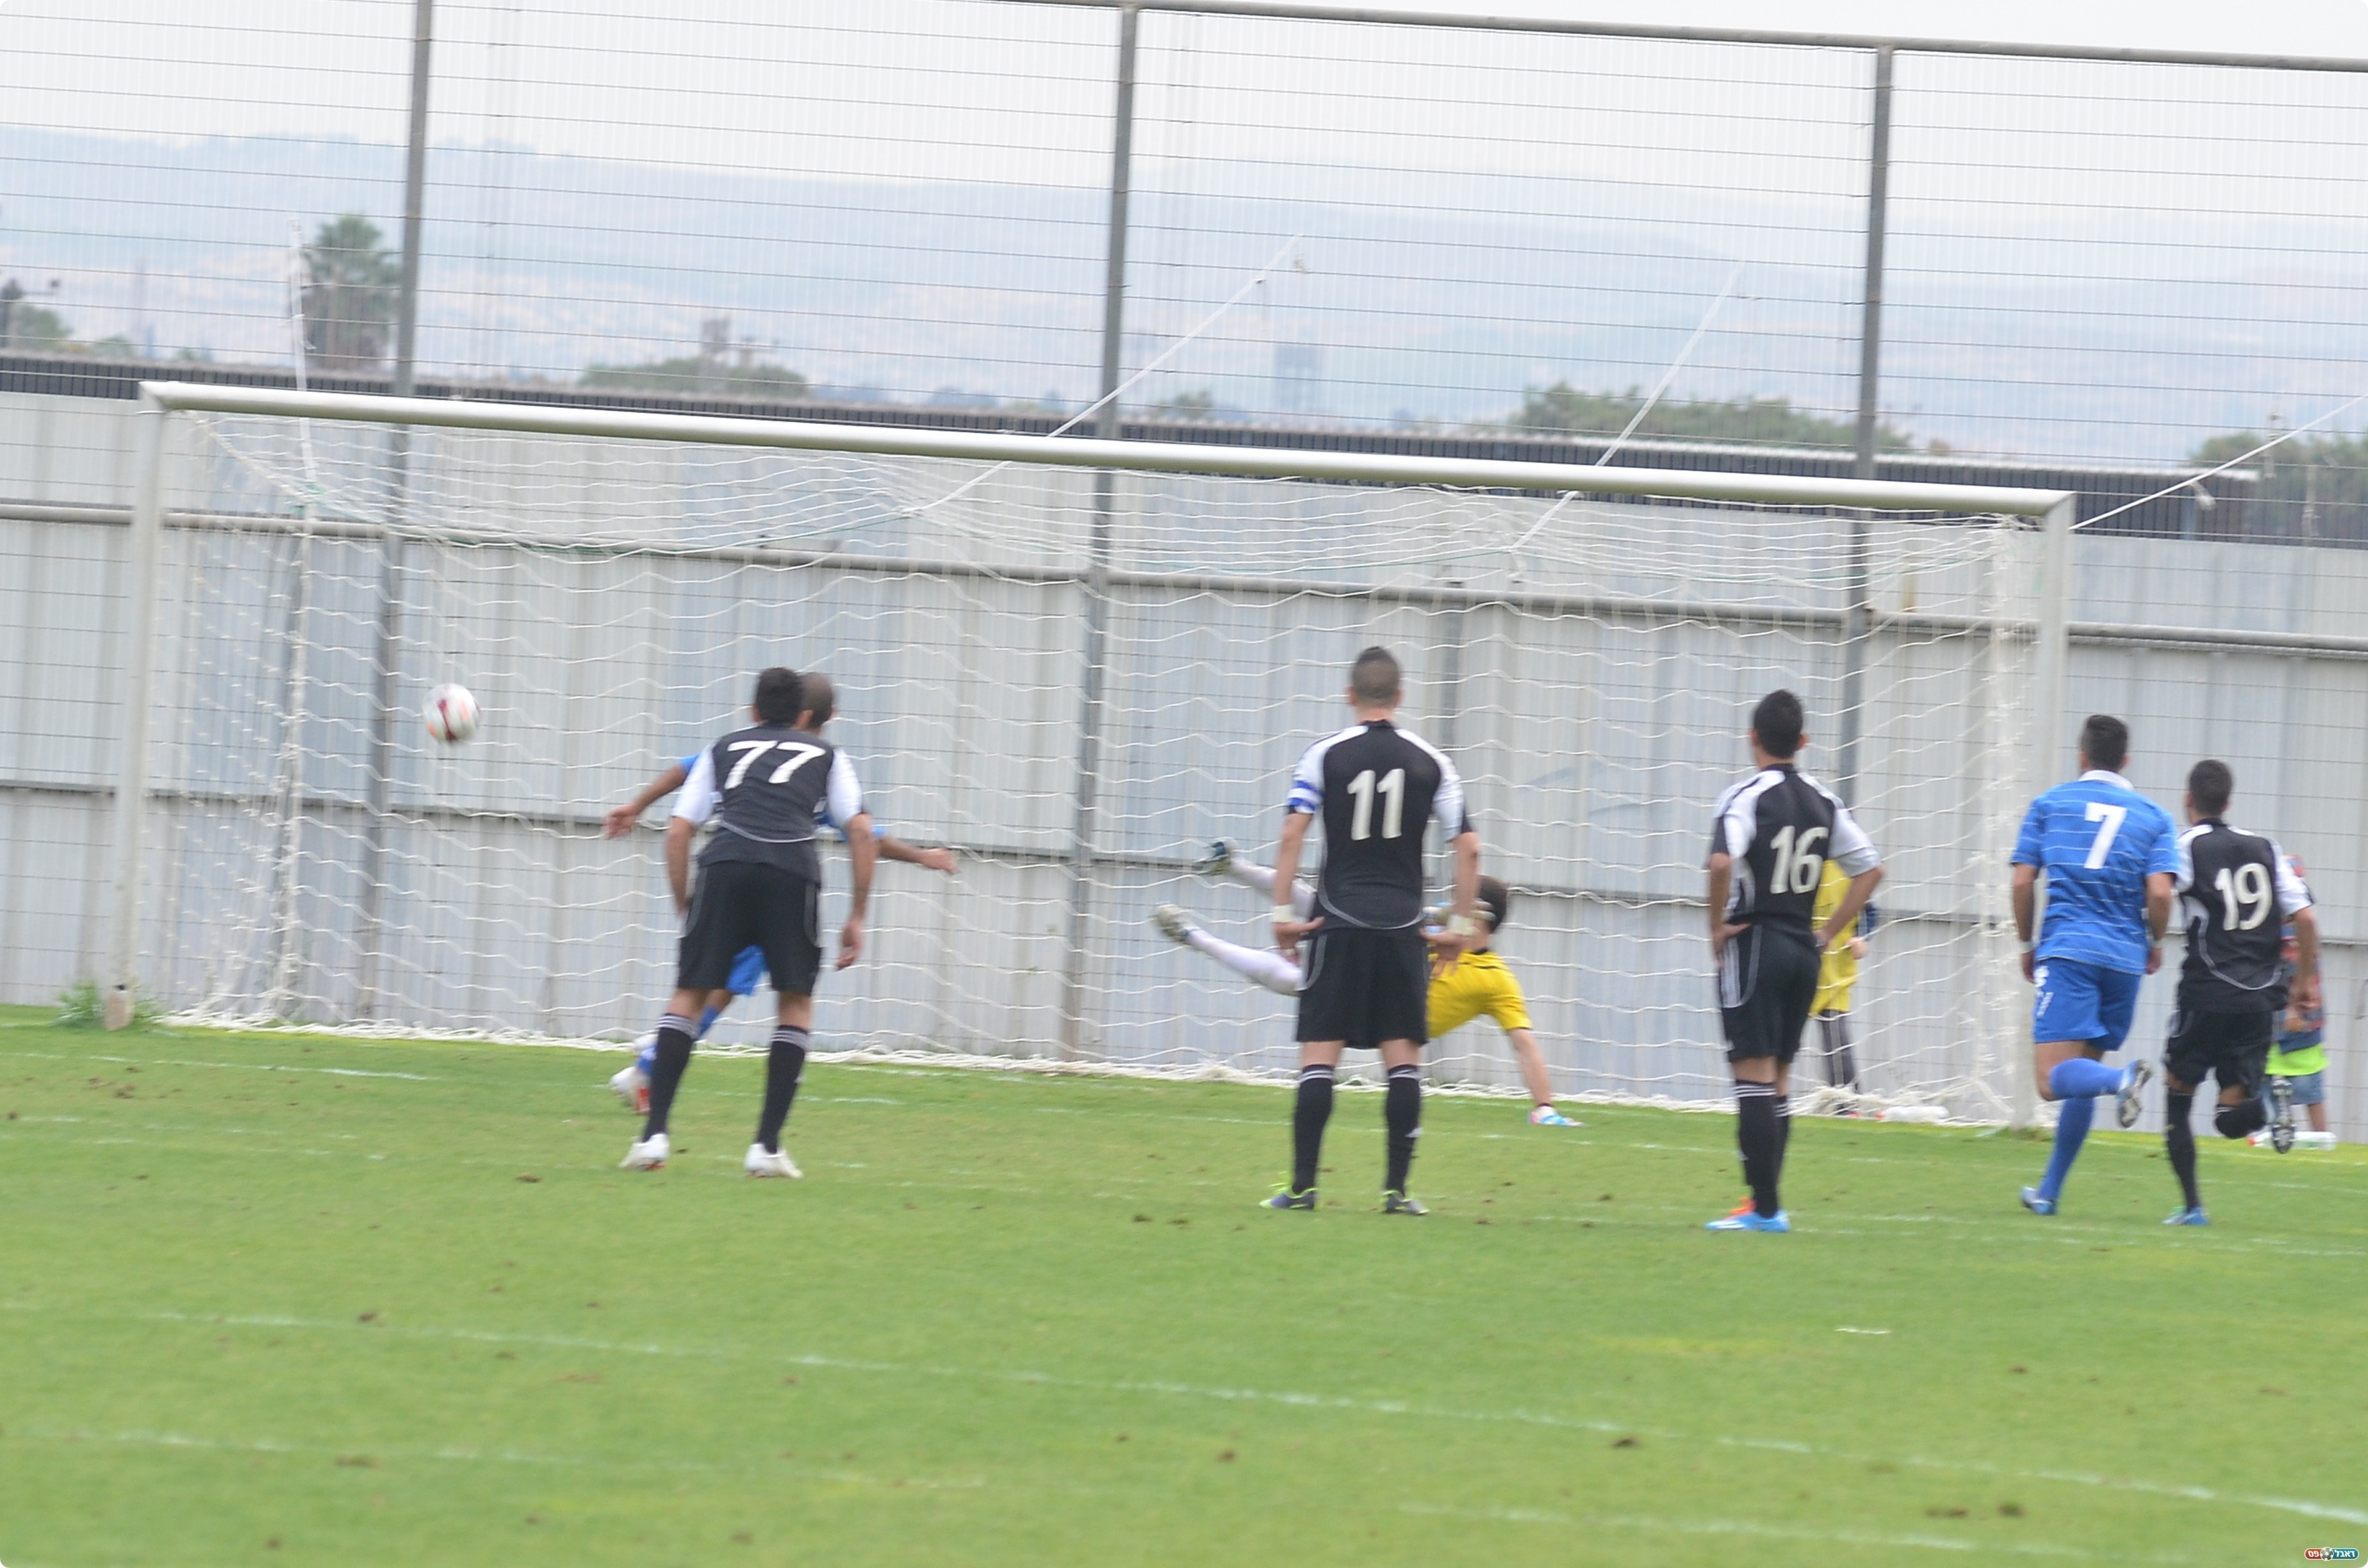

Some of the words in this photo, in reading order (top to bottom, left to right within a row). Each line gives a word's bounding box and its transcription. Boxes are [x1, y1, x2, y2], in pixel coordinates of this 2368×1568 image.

[724, 740, 826, 790] 77
[1347, 768, 1406, 841] 11
[2084, 801, 2128, 870] 7
[1769, 825, 1829, 895] 16
[2214, 862, 2273, 931] 19
